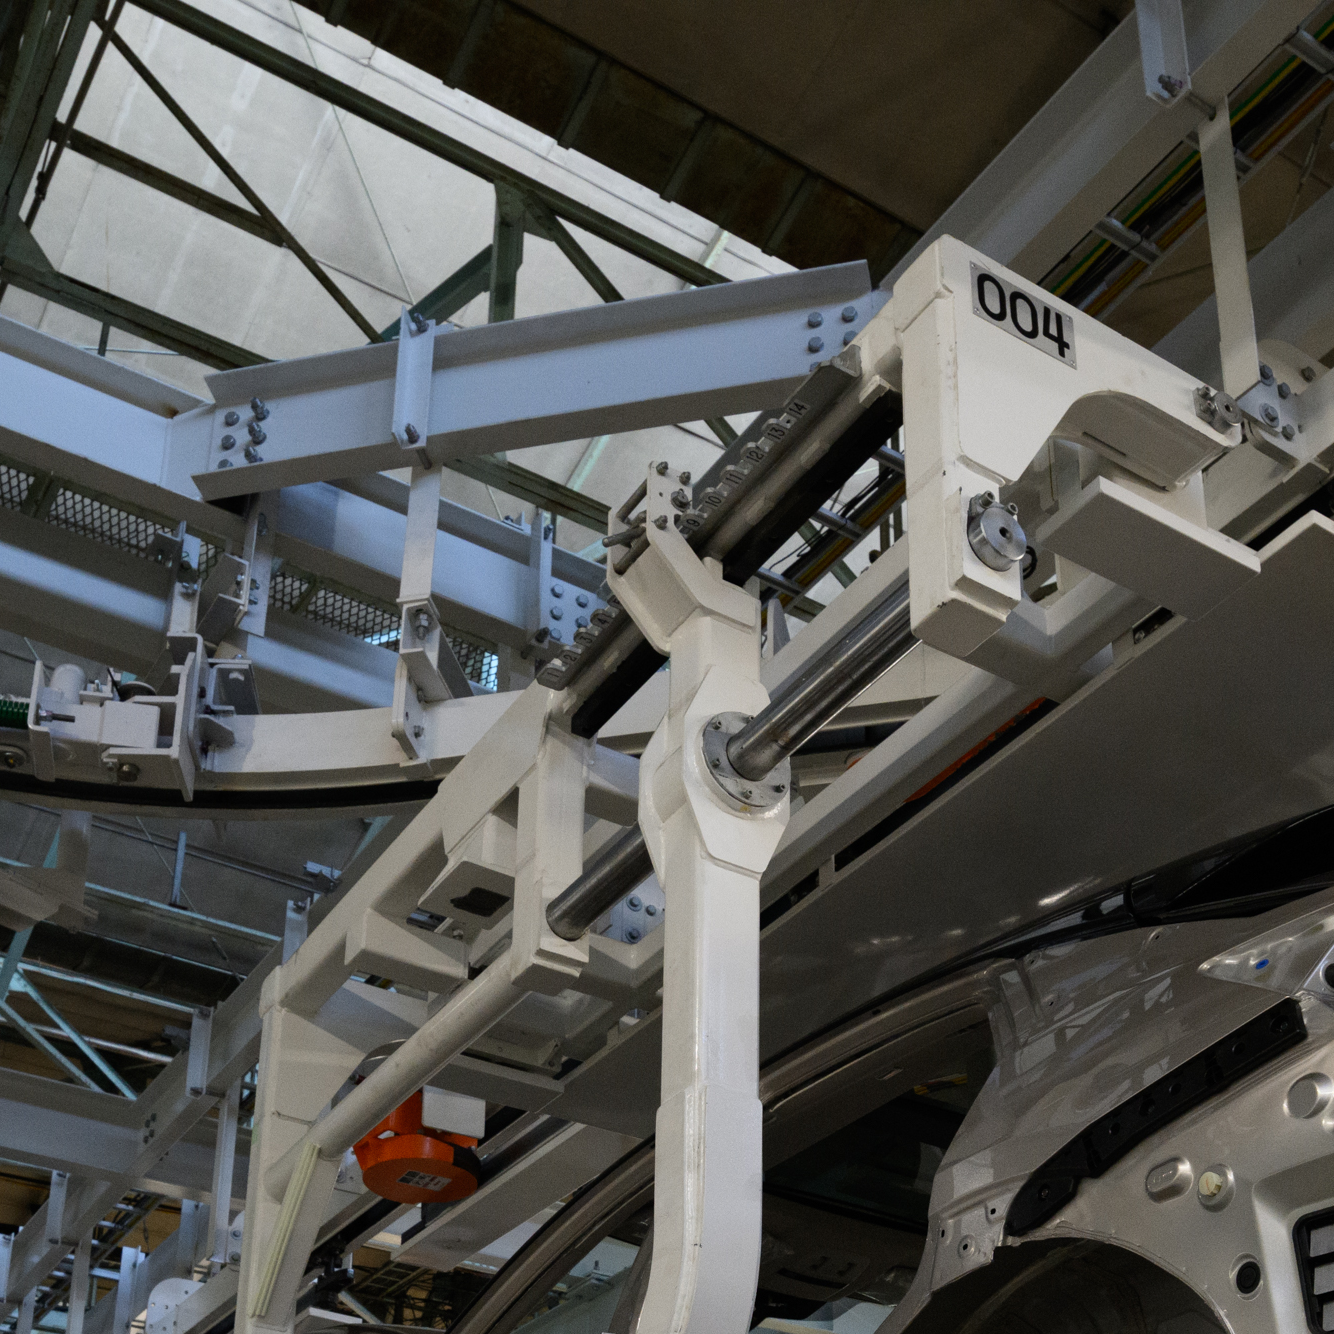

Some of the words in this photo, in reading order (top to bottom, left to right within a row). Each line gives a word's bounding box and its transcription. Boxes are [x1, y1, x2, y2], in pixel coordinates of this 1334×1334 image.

[977, 273, 1070, 358] 004
[686, 518, 701, 527] 9
[705, 495, 722, 507] 10
[725, 472, 744, 485] 11
[746, 449, 765, 462] 12
[767, 426, 786, 440] 13
[788, 401, 807, 416] 14
